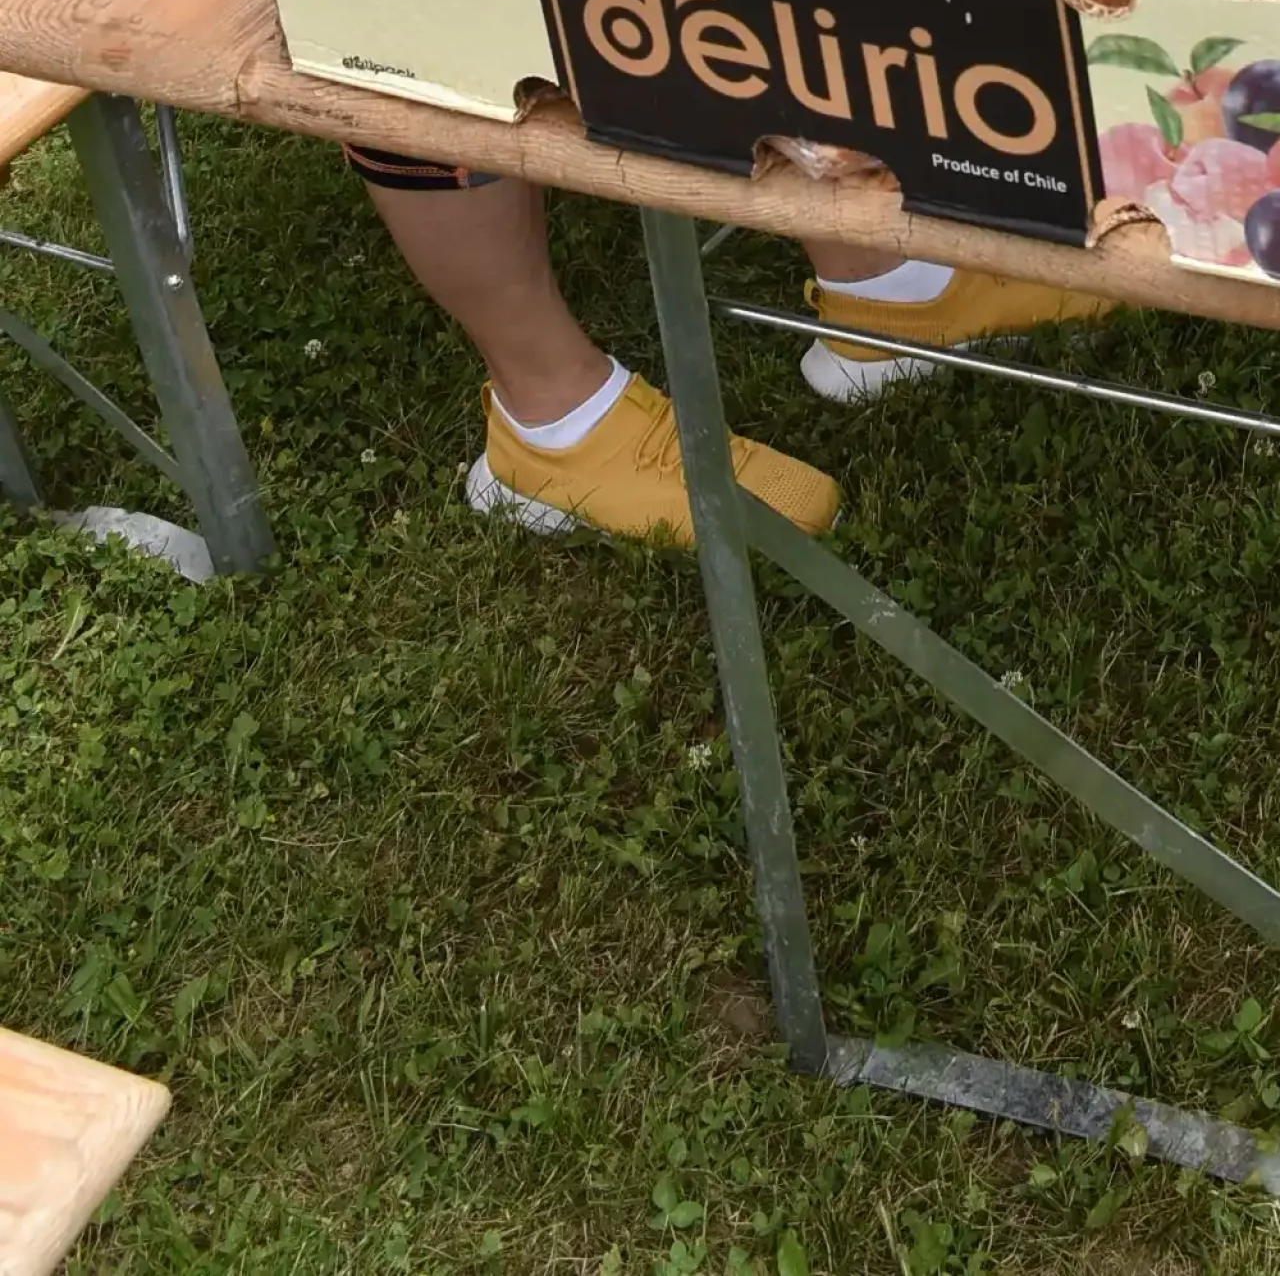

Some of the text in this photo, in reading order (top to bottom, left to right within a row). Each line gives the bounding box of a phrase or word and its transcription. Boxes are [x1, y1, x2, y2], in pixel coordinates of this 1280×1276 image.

[931, 152, 1068, 193] Produce of Chile
